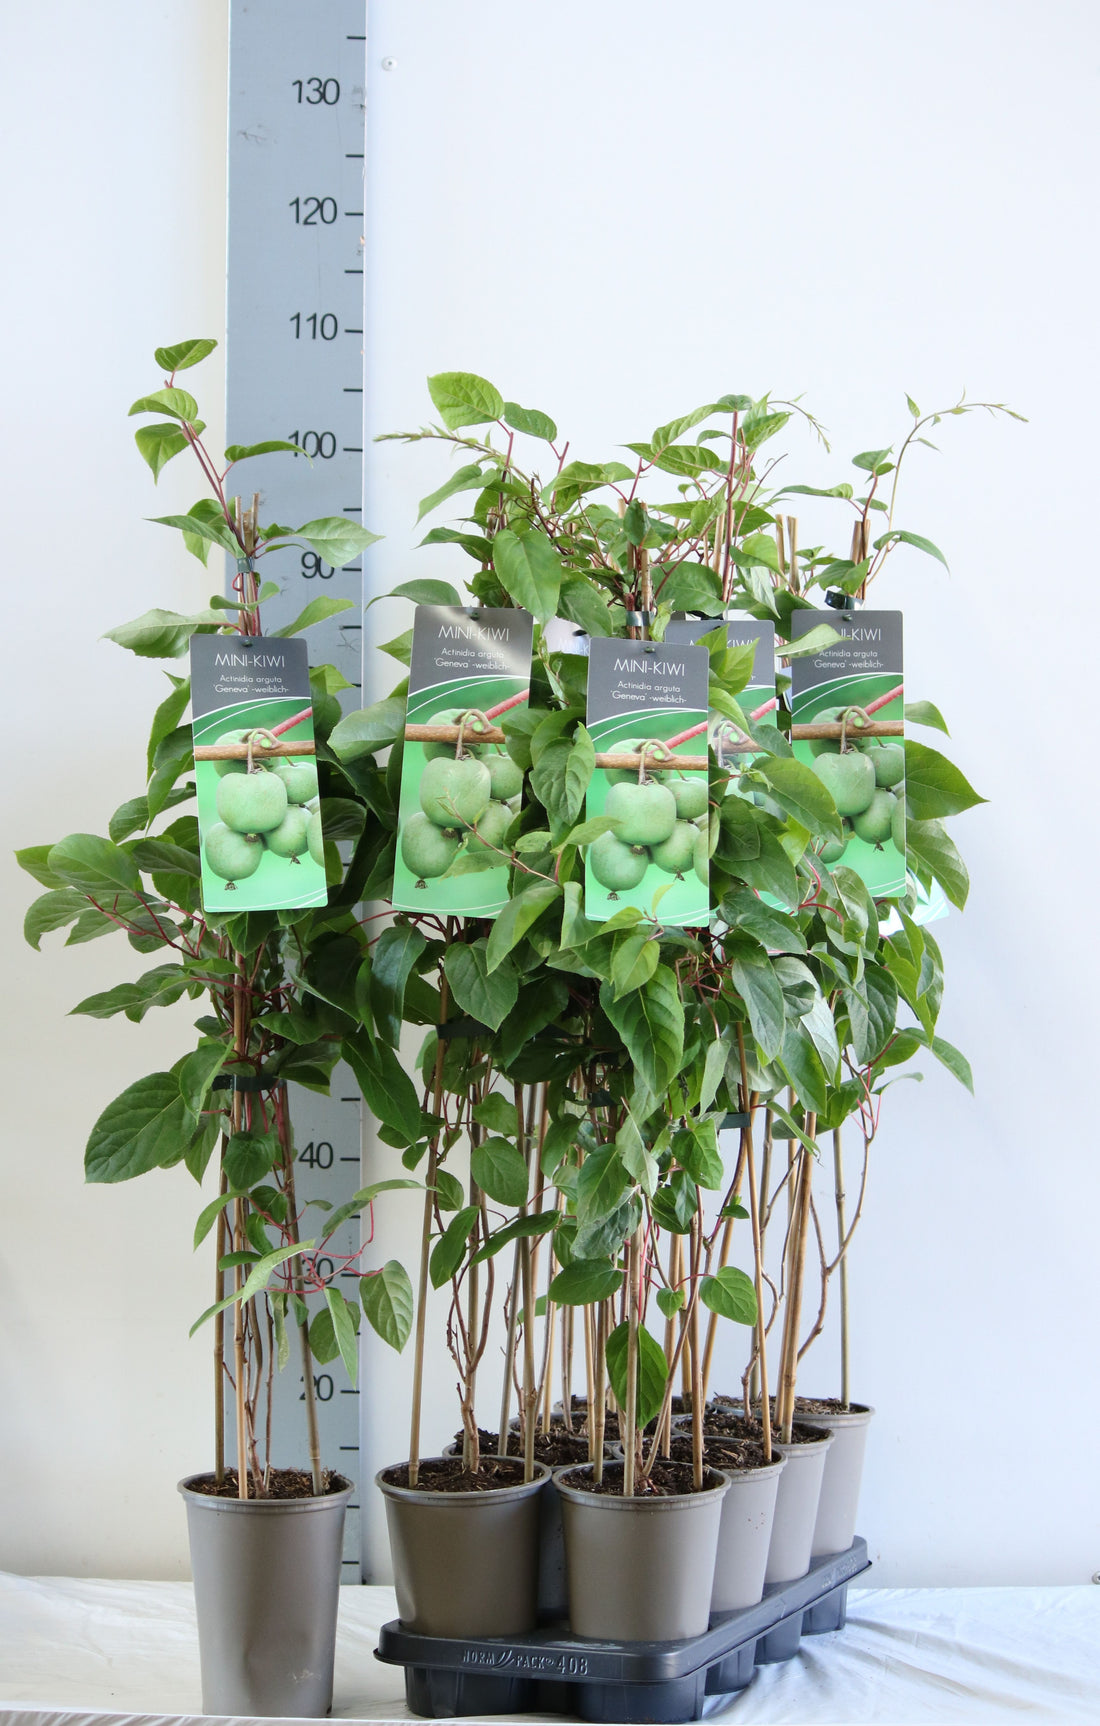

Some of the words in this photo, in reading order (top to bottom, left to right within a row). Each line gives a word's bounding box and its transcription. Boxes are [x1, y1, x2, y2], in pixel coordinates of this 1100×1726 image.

[292, 77, 340, 105] 130
[289, 196, 338, 225] 120
[289, 312, 338, 341] 110
[288, 430, 337, 459] 100
[301, 551, 335, 579] 90
[438, 625, 510, 641] MINI-KIWI
[841, 628, 881, 641] I-KIWI
[214, 653, 285, 668] MINI-KIWI
[441, 647, 475, 657] Actinidia
[478, 650, 504, 660] arguta
[819, 649, 851, 657] Actinidia
[853, 650, 878, 659] arguta
[613, 658, 685, 676] MINI-KIWI
[848, 660, 884, 669] -weiblich-
[220, 674, 254, 683] Actinidia
[255, 676, 282, 685] arguta
[617, 680, 652, 692] Actinidia
[654, 685, 681, 694] arguta
[251, 685, 289, 694] -weiblich-
[649, 694, 687, 704] -weiblich-
[298, 1141, 334, 1169] 40
[463, 1649, 496, 1665] NORM
[558, 1655, 588, 1676] 408
